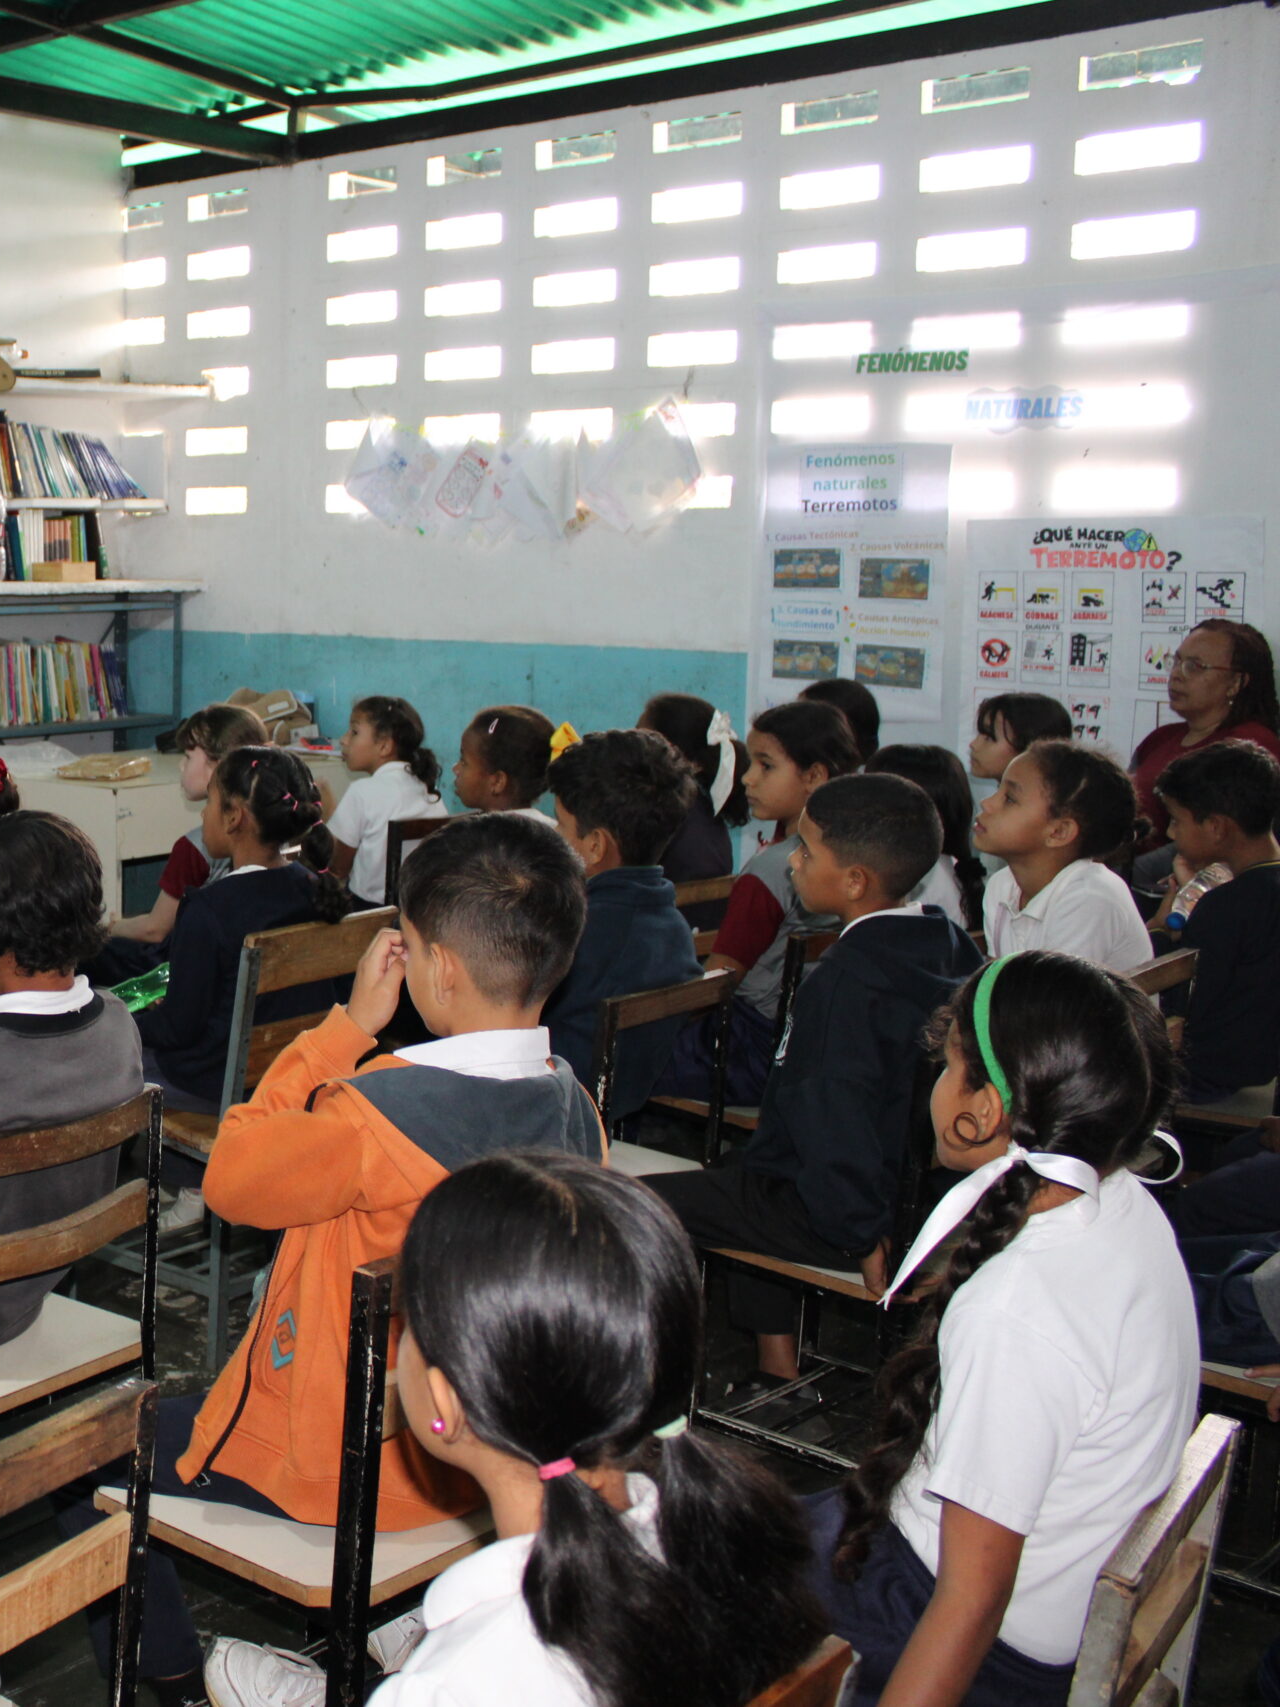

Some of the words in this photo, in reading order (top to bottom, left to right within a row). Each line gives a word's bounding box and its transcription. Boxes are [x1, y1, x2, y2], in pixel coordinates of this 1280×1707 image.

[855, 347, 969, 374] FENÓMENOS
[965, 396, 1083, 422] NATURALES
[805, 452, 896, 469] Fenómenos
[813, 475, 888, 491] naturales
[801, 497, 898, 514] Terremotos
[774, 533, 808, 543] Causas
[809, 530, 859, 542] Tectónicas
[1033, 527, 1073, 545] ¿QUÉ
[1076, 529, 1125, 543] HACER
[860, 542, 892, 552] Causas
[894, 540, 945, 552] Volcánicas
[1095, 542, 1109, 550] UN
[787, 605, 820, 616] Causas
[821, 606, 833, 616] de
[858, 612, 889, 623] Causas
